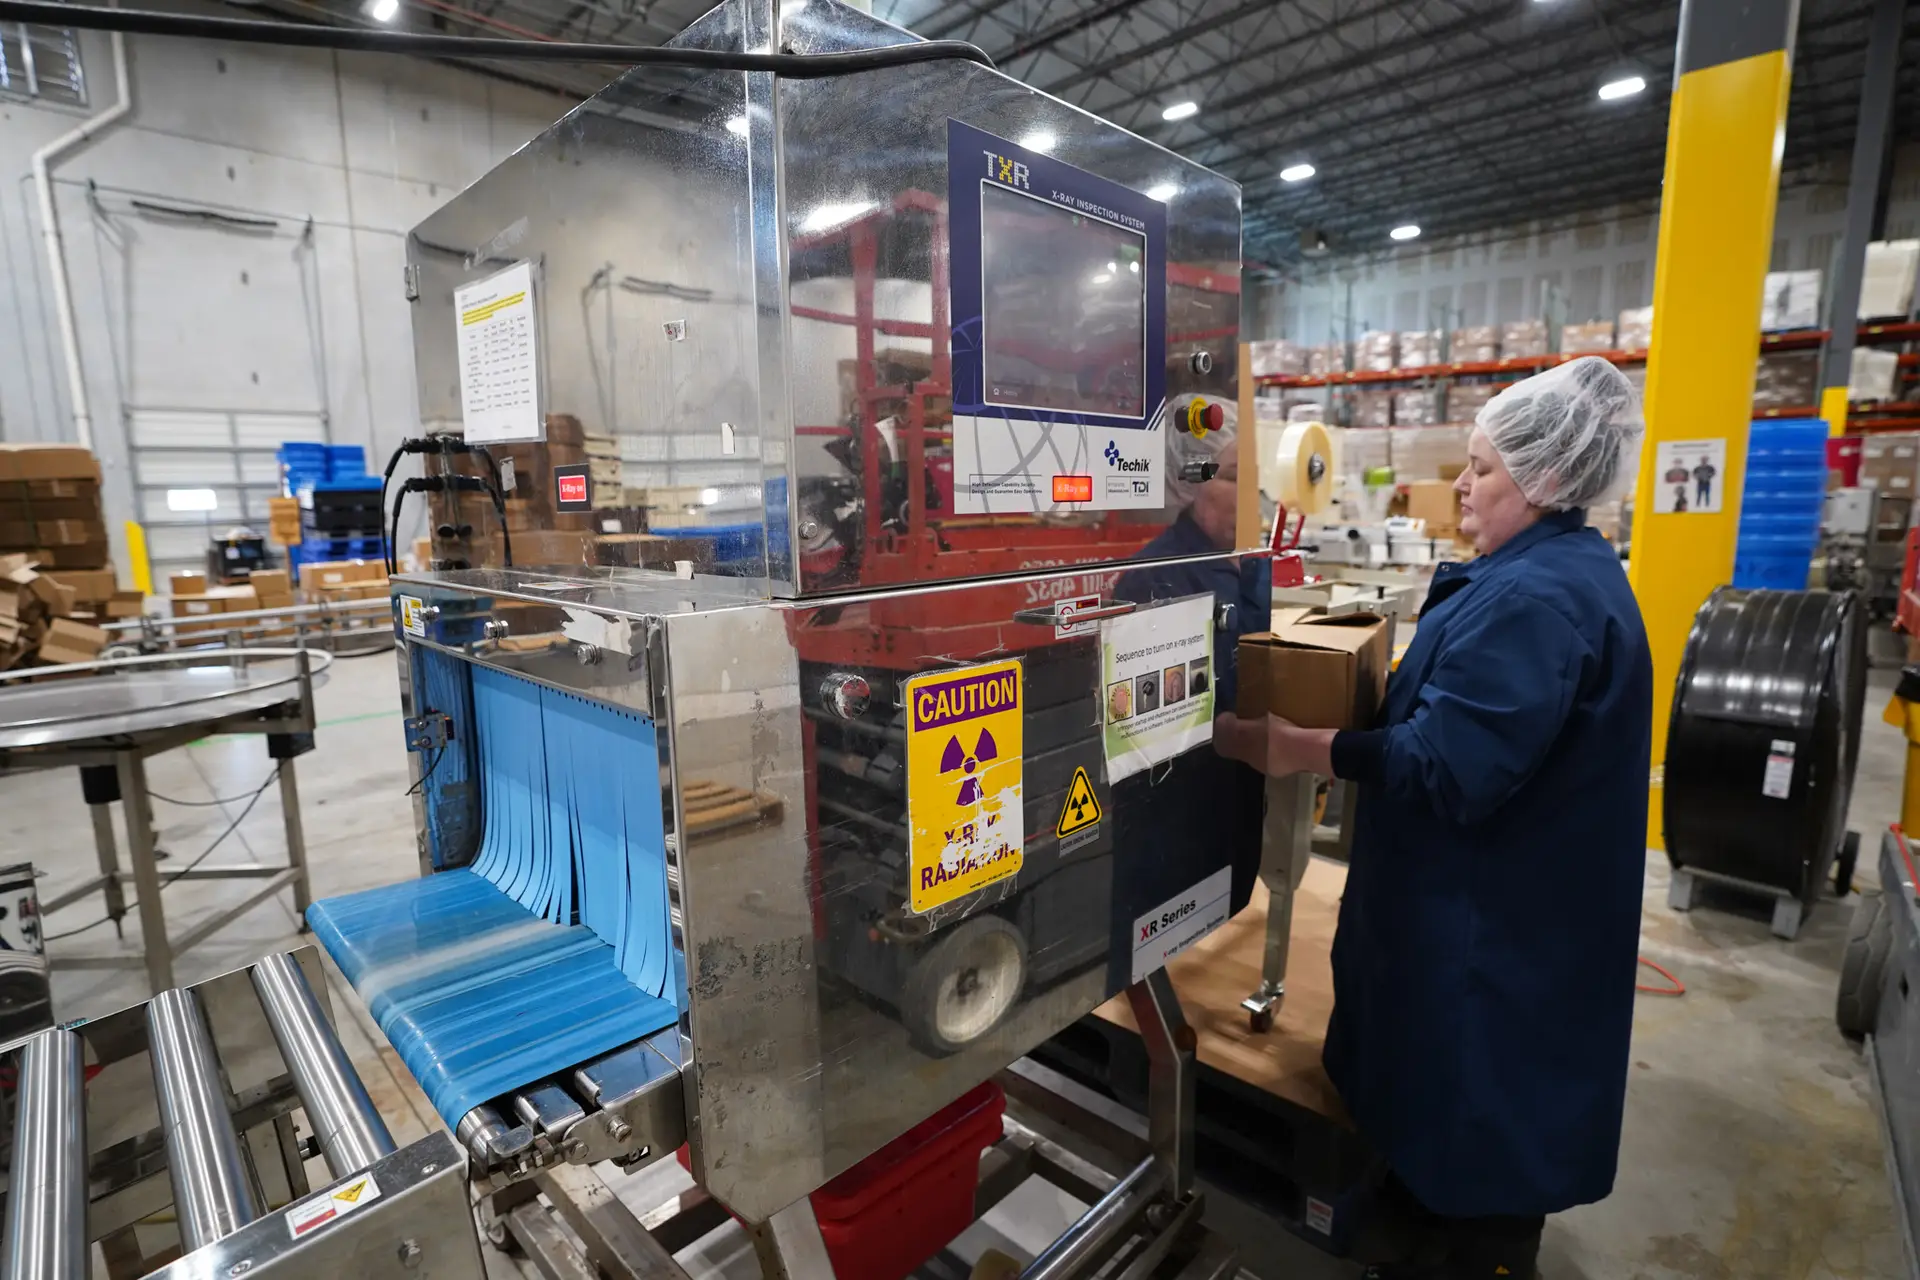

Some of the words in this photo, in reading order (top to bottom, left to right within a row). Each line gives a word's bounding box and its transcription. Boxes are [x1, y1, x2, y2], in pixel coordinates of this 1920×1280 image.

[983, 150, 1030, 190] TXR
[1052, 190, 1075, 208] X-RAY
[1077, 198, 1119, 222] INSPECTION
[1120, 213, 1145, 230] SYSTEM
[1116, 457, 1150, 472] Techik
[1056, 483, 1078, 494] X-Ray
[1132, 481, 1149, 493] TDI
[1116, 648, 1145, 664] Sequence
[1145, 647, 1153, 656] to
[1153, 644, 1166, 653] turn
[1166, 641, 1173, 650] on
[1174, 638, 1187, 650] x-ray
[1187, 634, 1205, 646] system
[918, 676, 1015, 723] CAUTION
[1140, 920, 1158, 942] XR
[1161, 900, 1196, 928] Series
